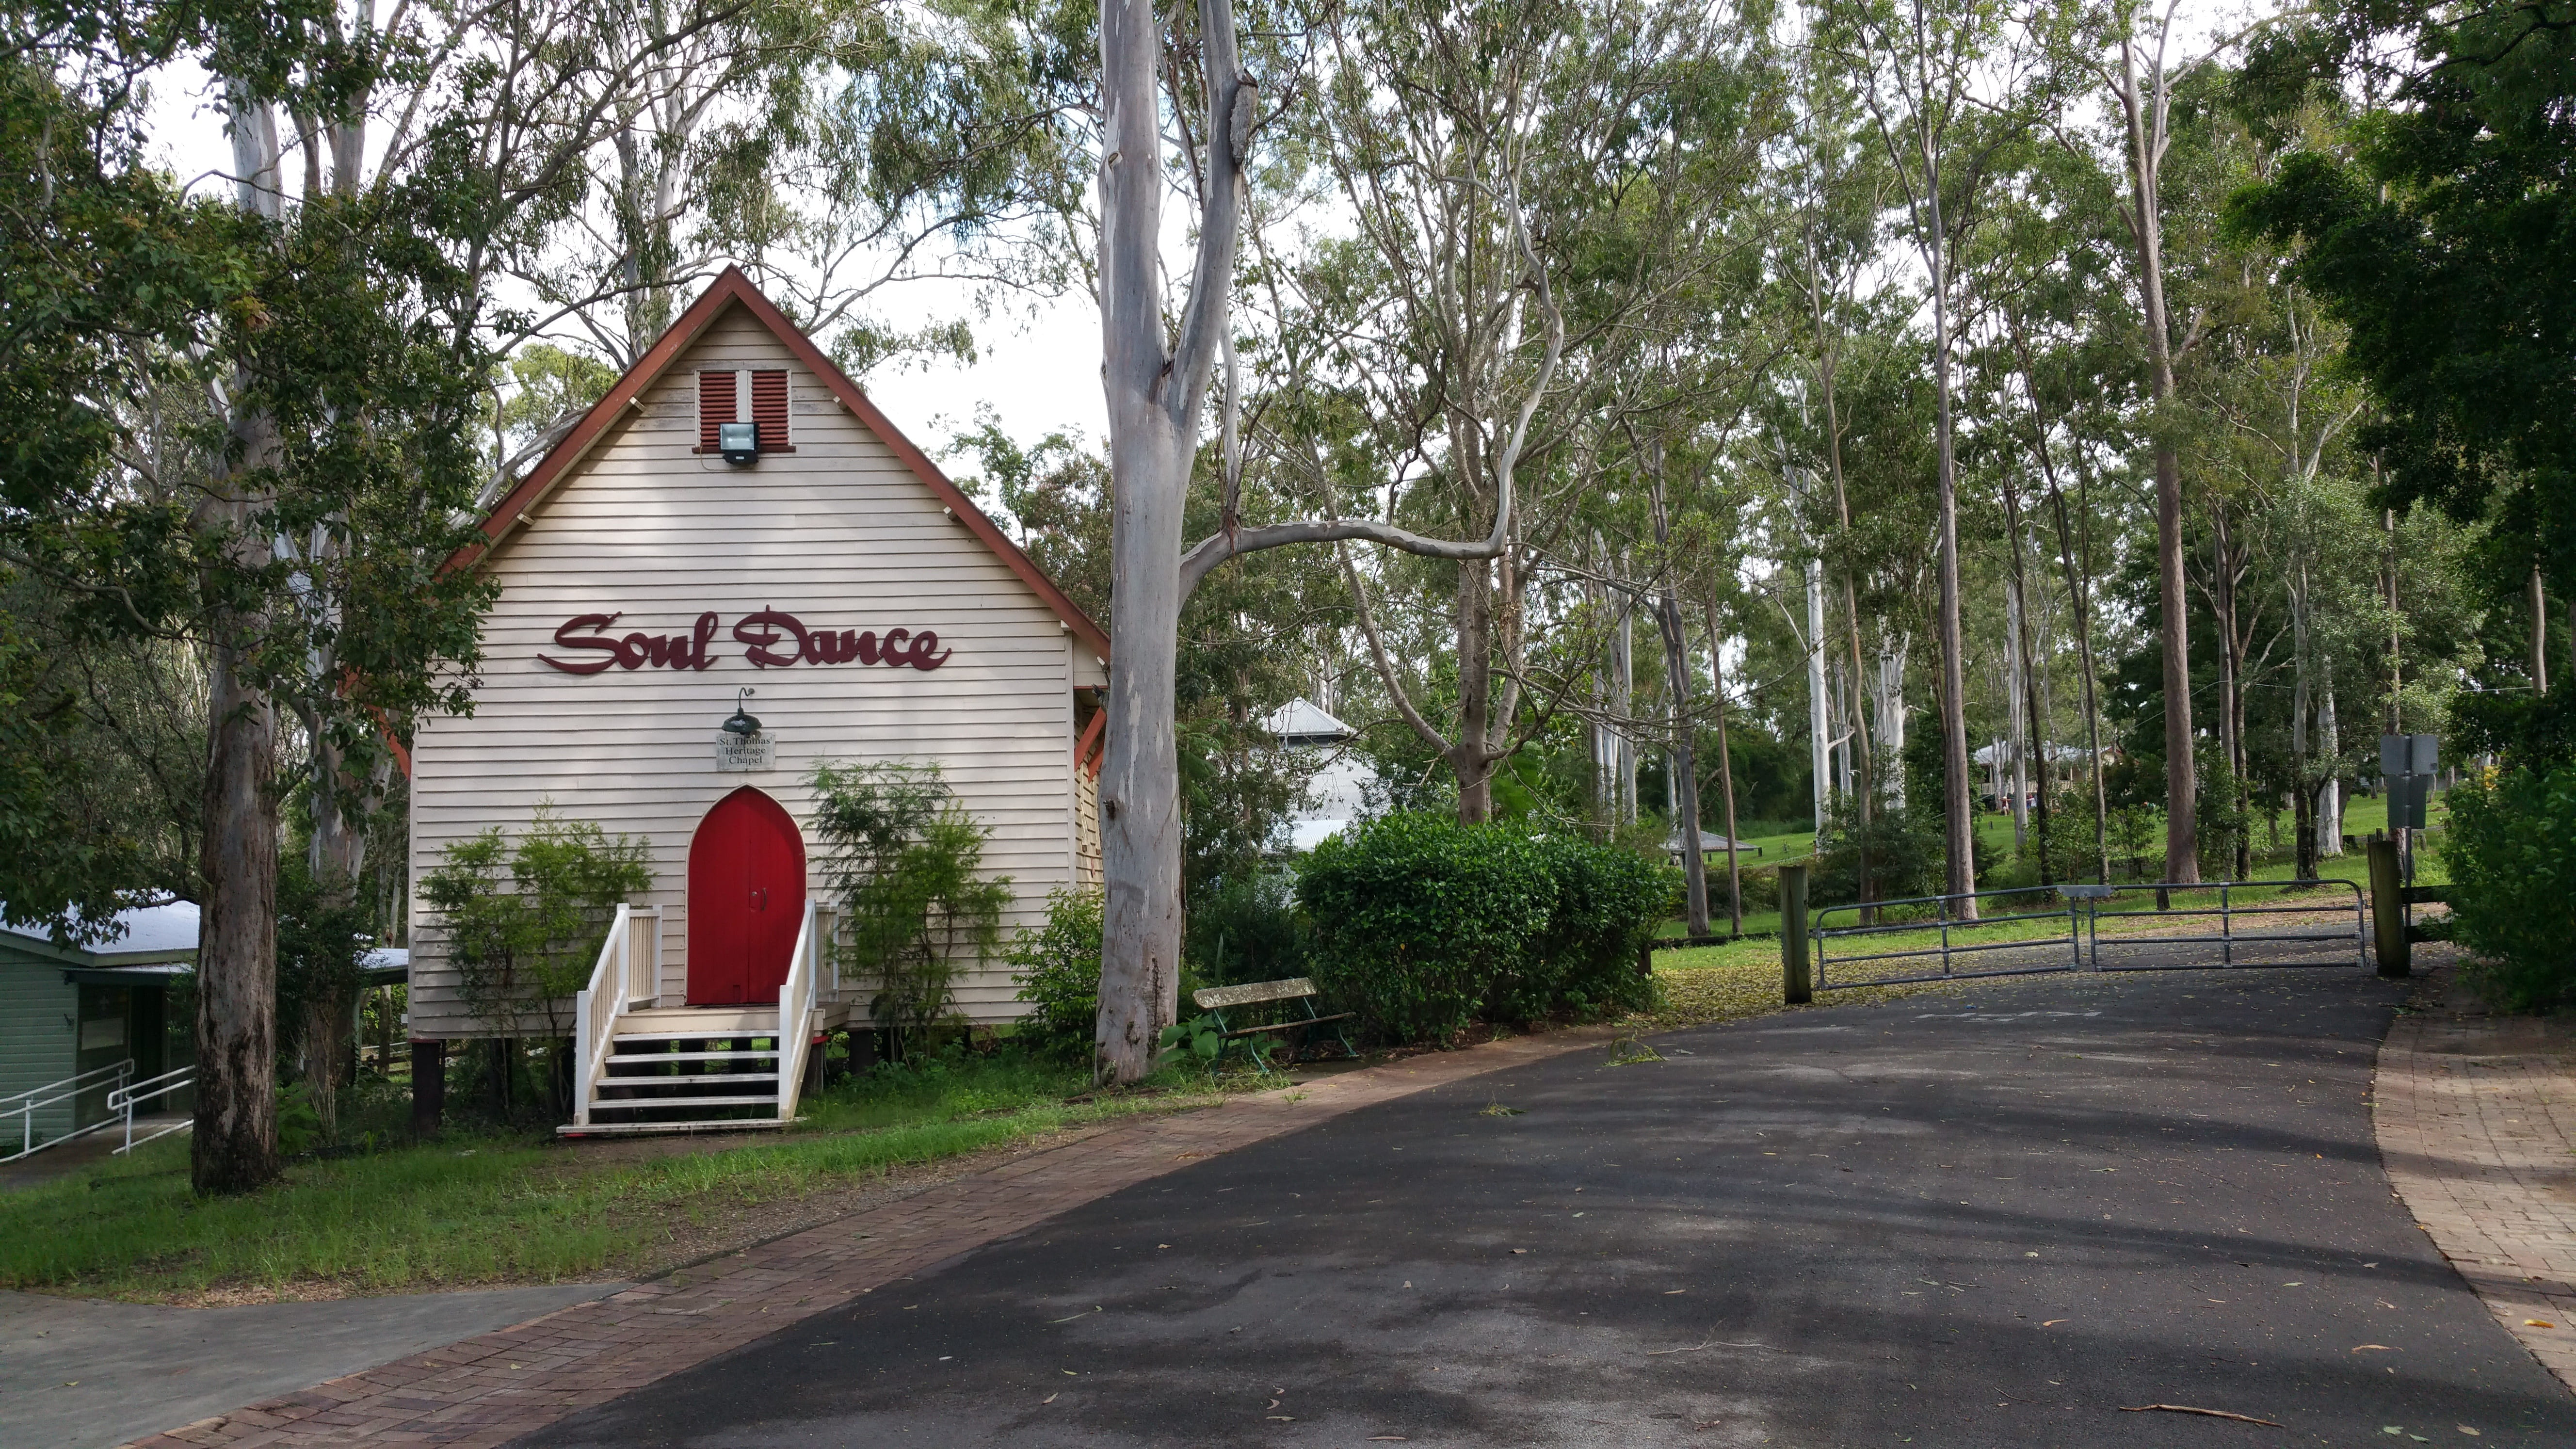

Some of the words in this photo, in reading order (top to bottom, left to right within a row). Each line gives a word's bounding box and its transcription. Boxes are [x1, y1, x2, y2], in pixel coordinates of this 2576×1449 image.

[538, 611, 719, 674] Soul
[732, 604, 952, 671] Dance
[729, 756, 762, 765] Chapel
